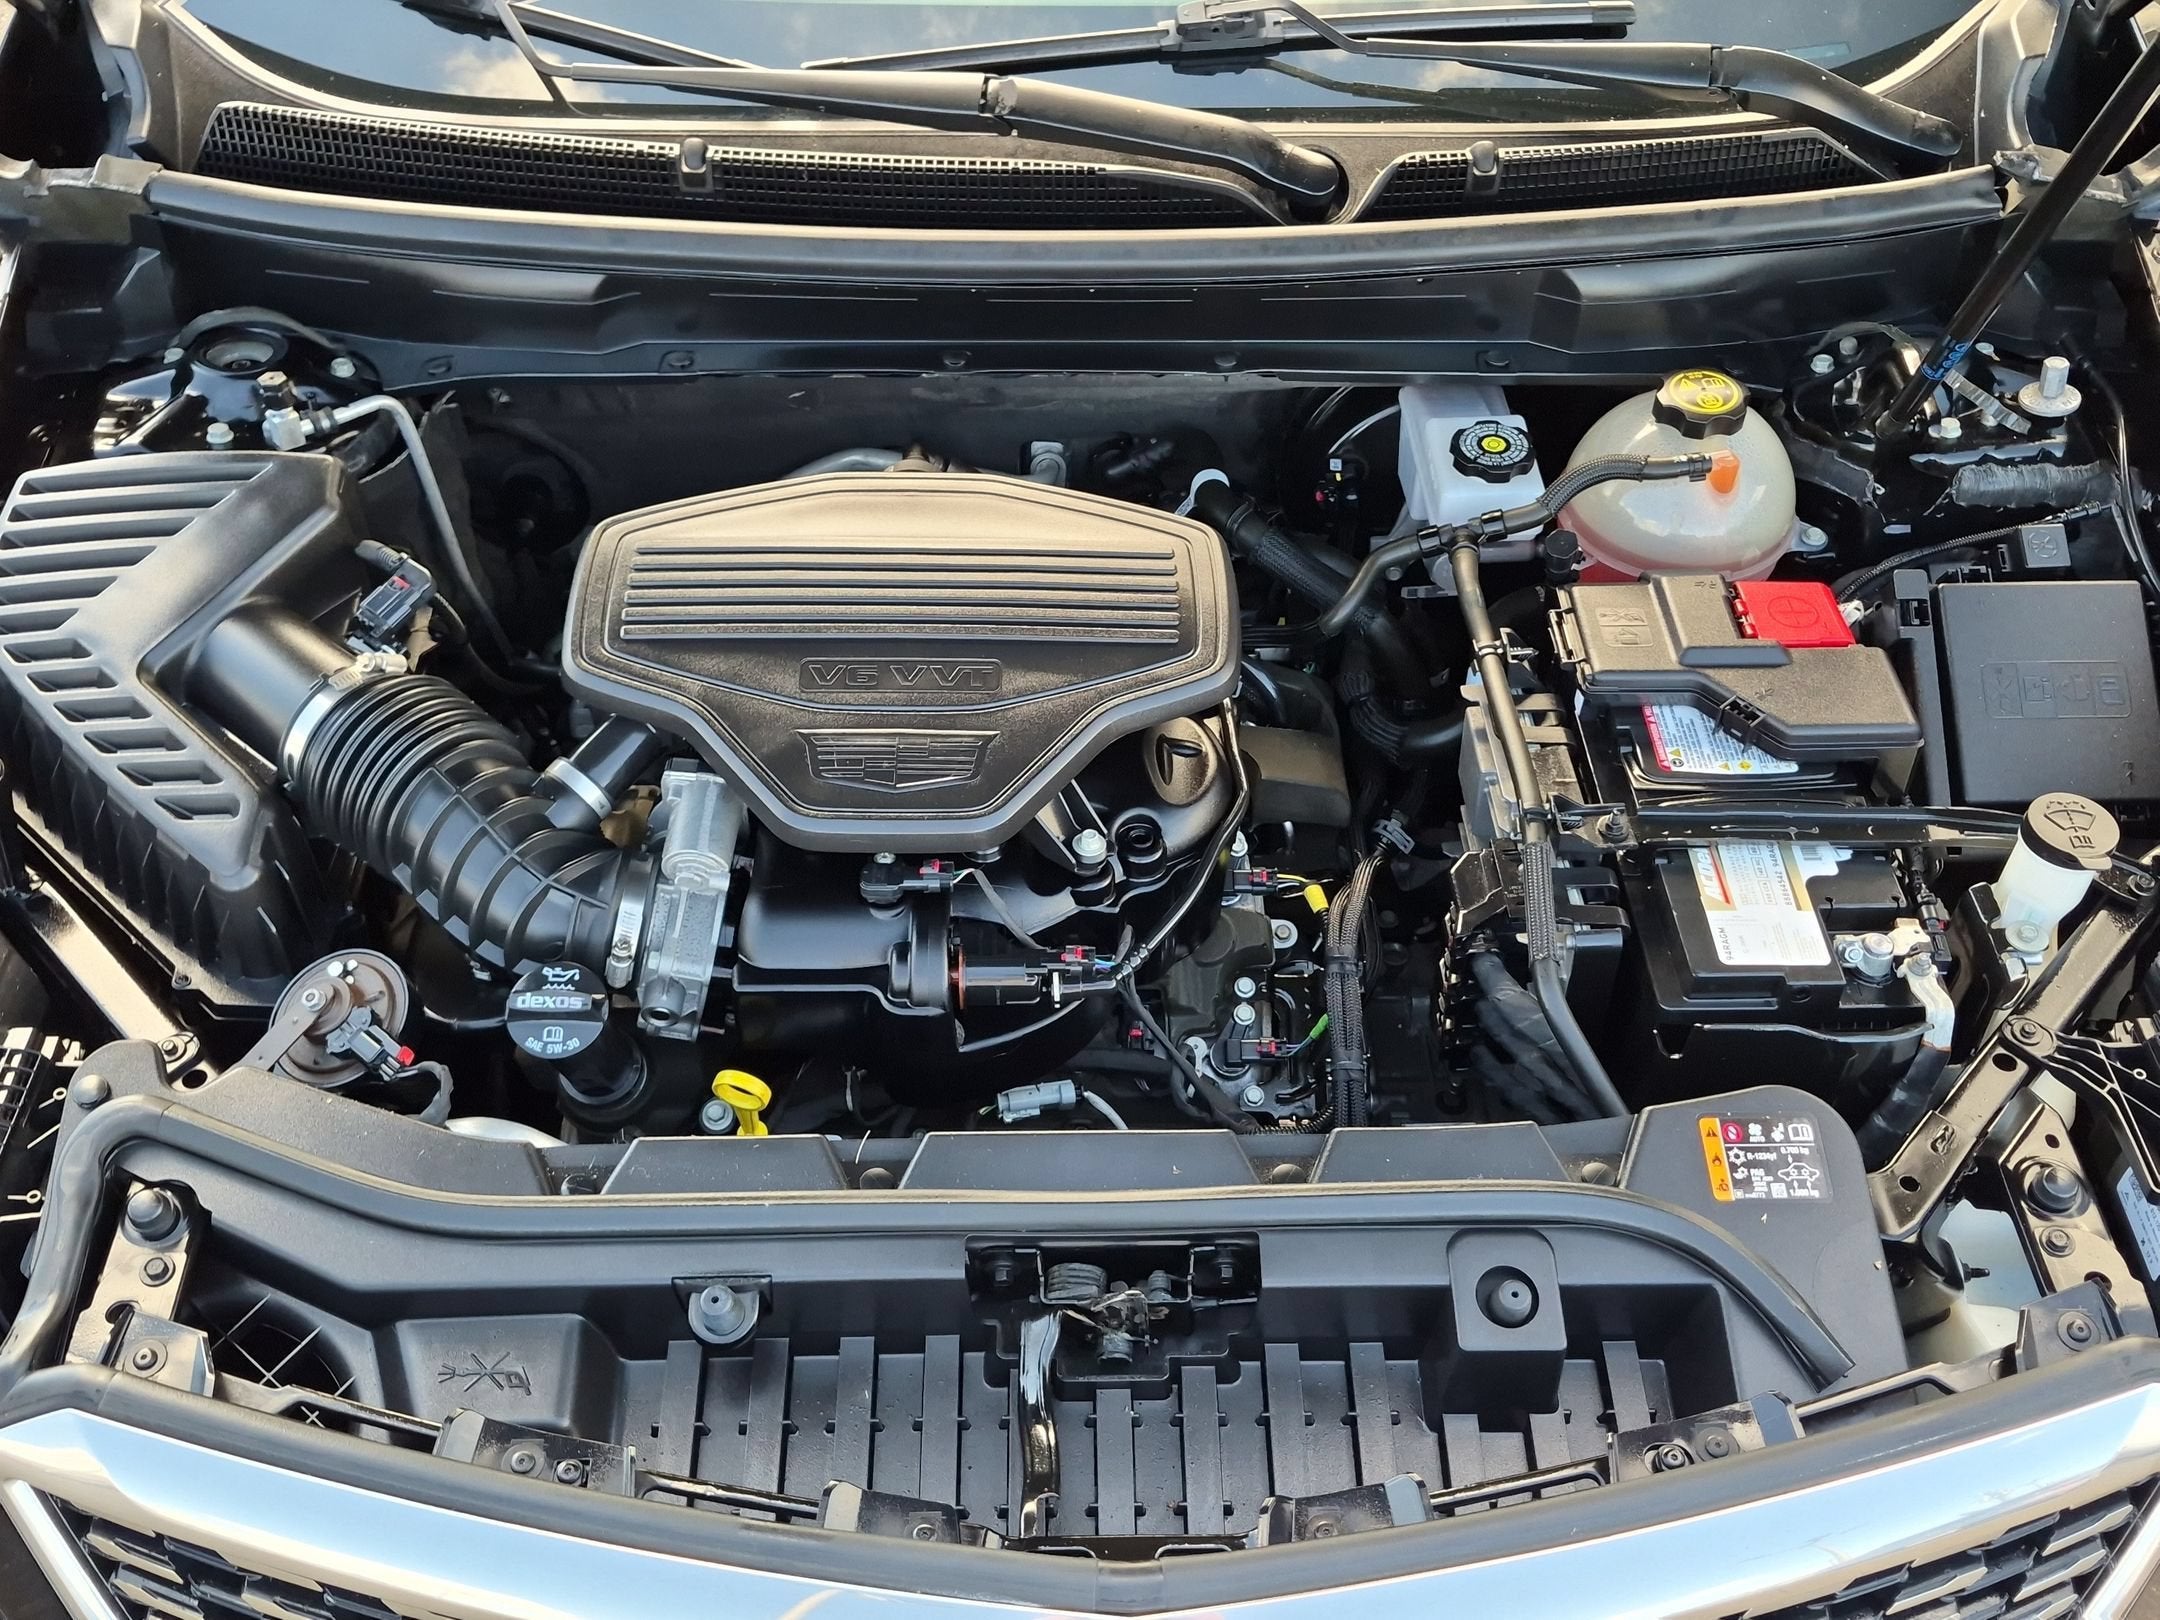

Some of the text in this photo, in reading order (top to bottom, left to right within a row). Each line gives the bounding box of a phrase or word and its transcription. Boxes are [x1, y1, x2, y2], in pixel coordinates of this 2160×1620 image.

[808, 664, 995, 687] V6 VVT
[1717, 928, 1733, 960] 94RAGM
[516, 992, 585, 1009] dexos
[525, 1036, 580, 1054] SAE 5W-30
